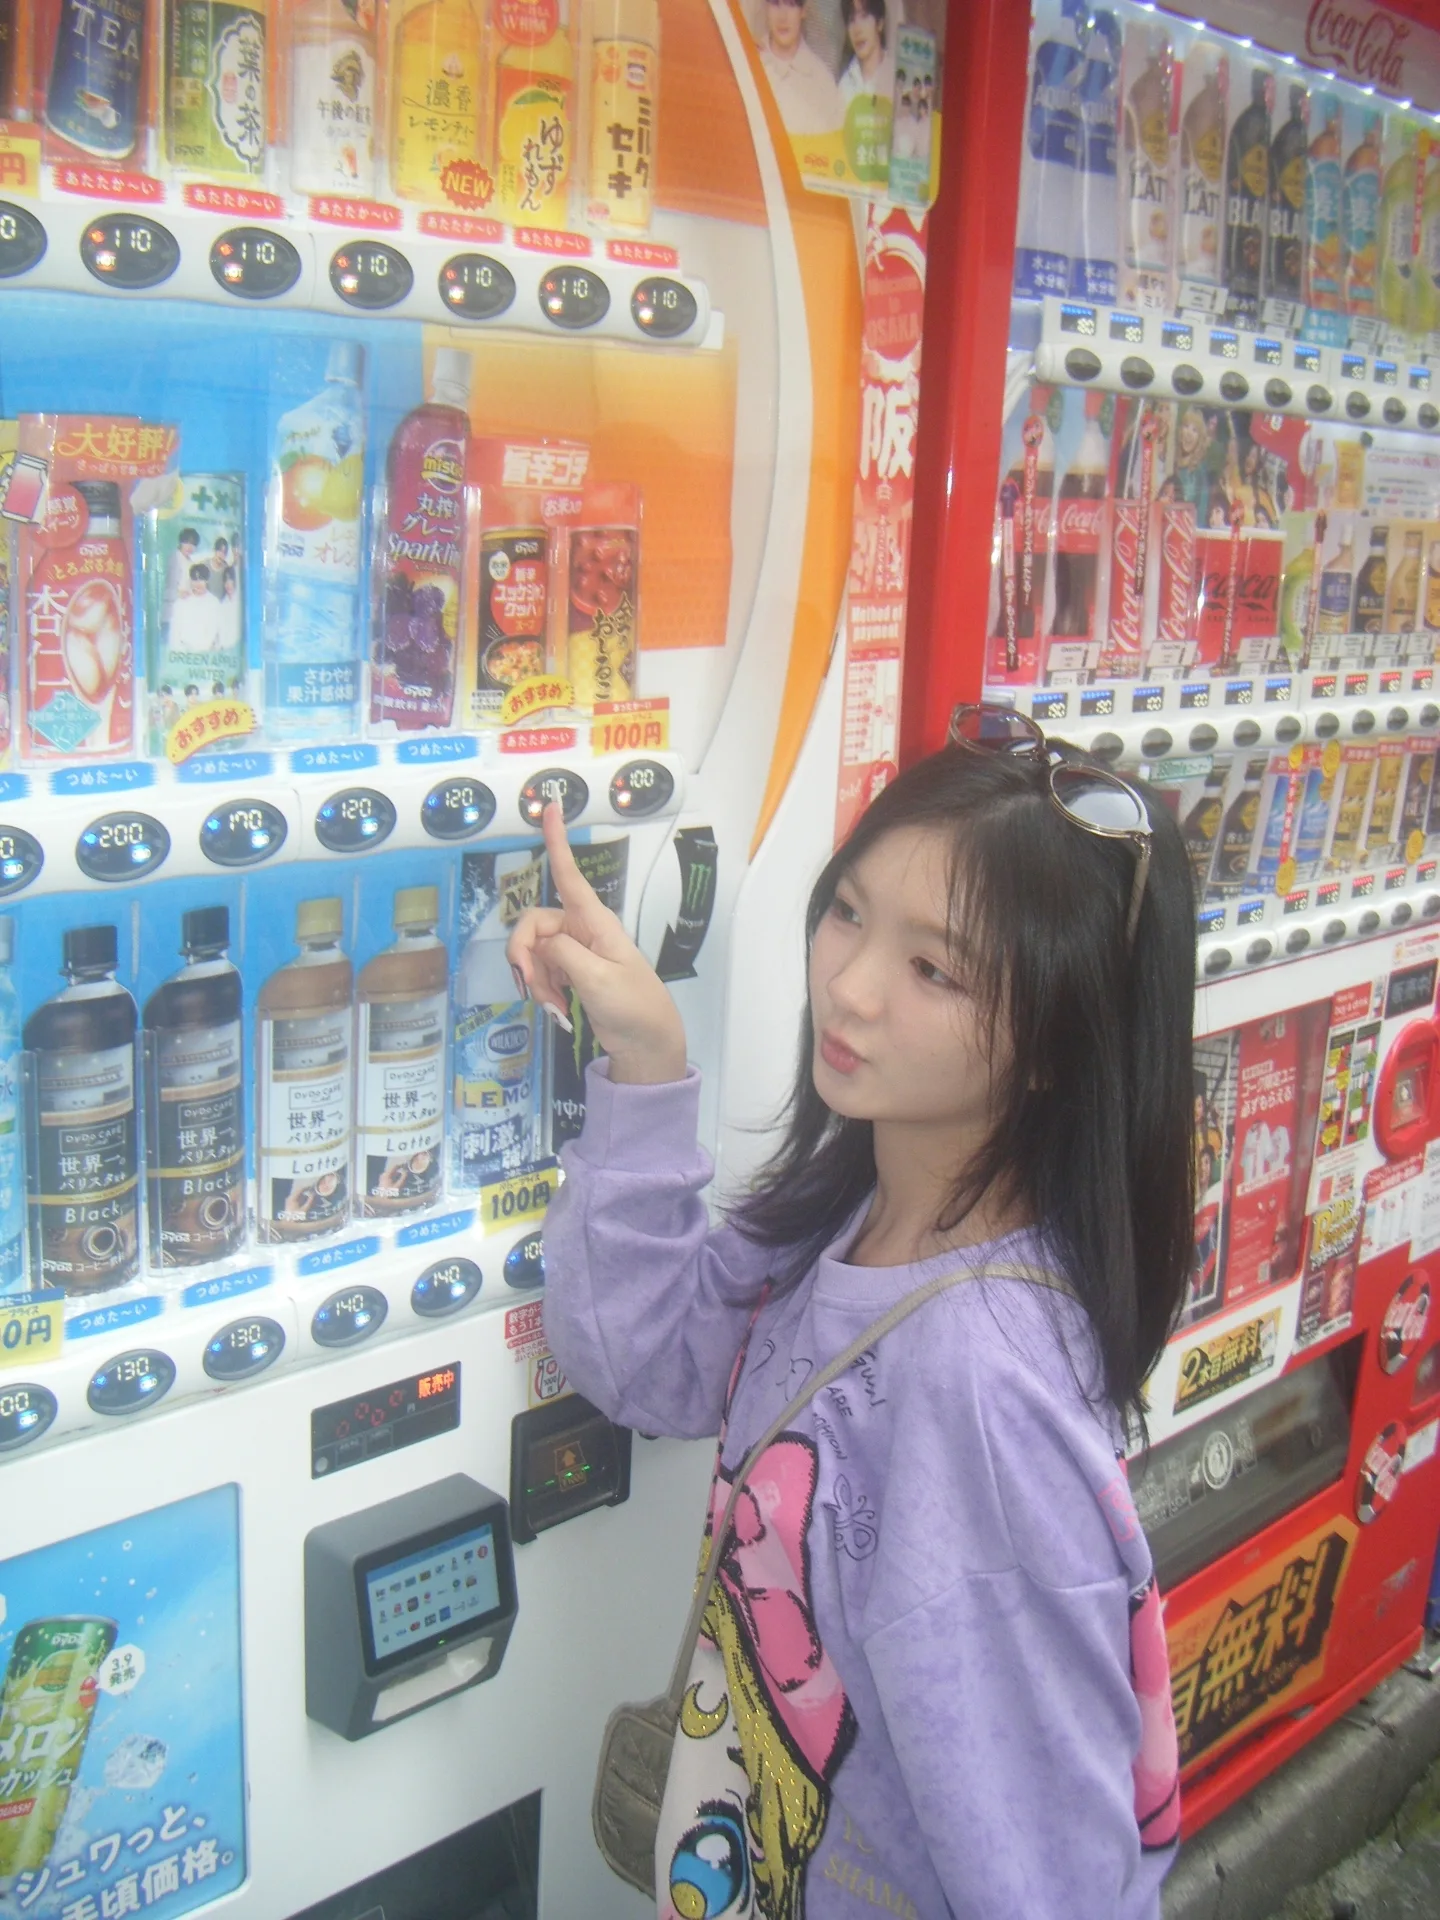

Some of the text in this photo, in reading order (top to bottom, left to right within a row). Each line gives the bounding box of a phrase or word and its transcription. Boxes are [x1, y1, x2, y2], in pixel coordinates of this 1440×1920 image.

[72, 0, 140, 60] TEA
[540, 116, 564, 195] ゆず
[606, 123, 635, 199] セーキ
[446, 171, 490, 199] NEW
[115, 229, 152, 253] 110
[242, 242, 276, 265] 110
[357, 254, 388, 275] 110
[464, 267, 493, 287] 110
[561, 279, 589, 298] 110
[653, 290, 678, 308] 110
[187, 667, 226, 682] WATER
[509, 682, 563, 713] おすすめ
[174, 708, 240, 747] おすすめ
[604, 721, 661, 750] 100円
[540, 778, 568, 799] 100
[629, 769, 655, 789] 100
[341, 798, 373, 820] 120
[444, 787, 474, 808] 120
[229, 809, 264, 832] 170
[99, 822, 144, 848] 200
[386, 1135, 431, 1152] Latte
[292, 1157, 339, 1175] Latte
[182, 1172, 233, 1195] Black
[492, 1180, 552, 1221] 100円
[64, 1204, 120, 1225] Black
[433, 1265, 461, 1288] 140
[336, 1294, 365, 1317] 140
[230, 1324, 261, 1348] 130
[116, 1356, 150, 1382] 130
[417, 1370, 455, 1399] 販売中
[111, 1653, 133, 1673] 3.9
[17, 1804, 206, 1908] シュワっと、
